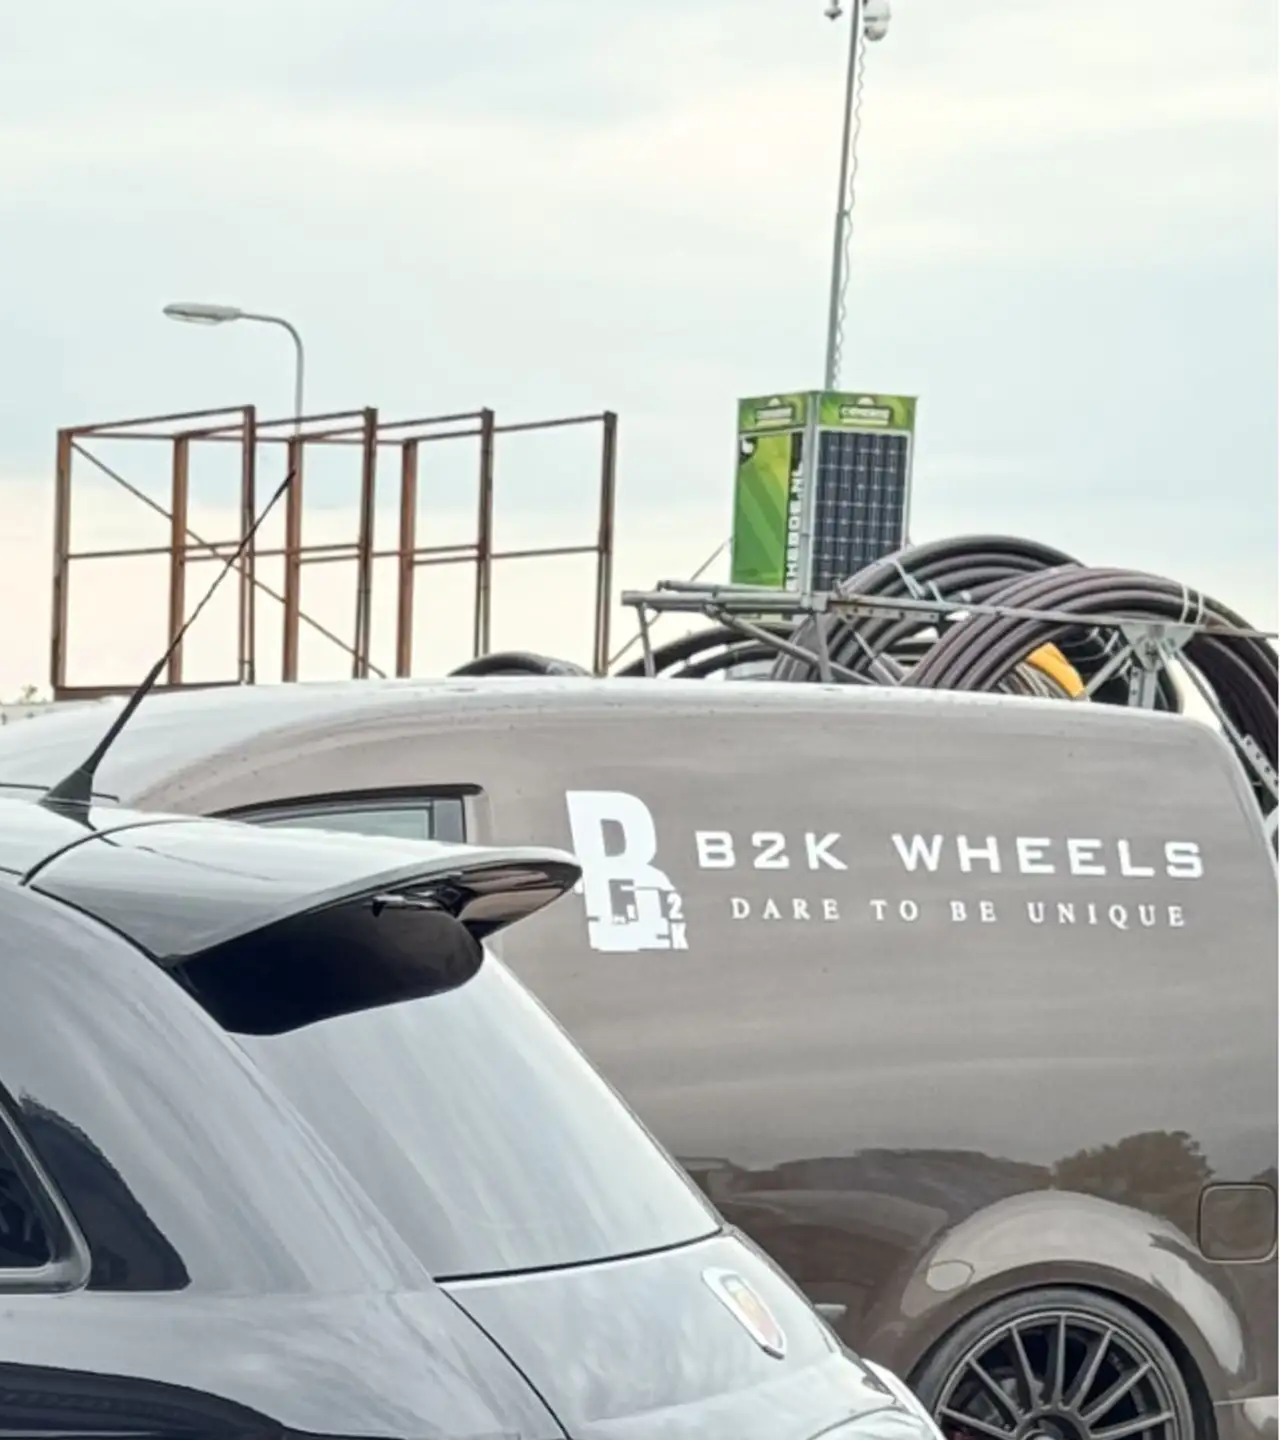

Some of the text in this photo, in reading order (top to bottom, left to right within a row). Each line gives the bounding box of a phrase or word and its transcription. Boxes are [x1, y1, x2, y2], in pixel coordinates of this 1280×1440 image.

[695, 830, 1204, 878] B2K WHEELS
[730, 897, 1186, 929] DARE TO BE UNIQUE
